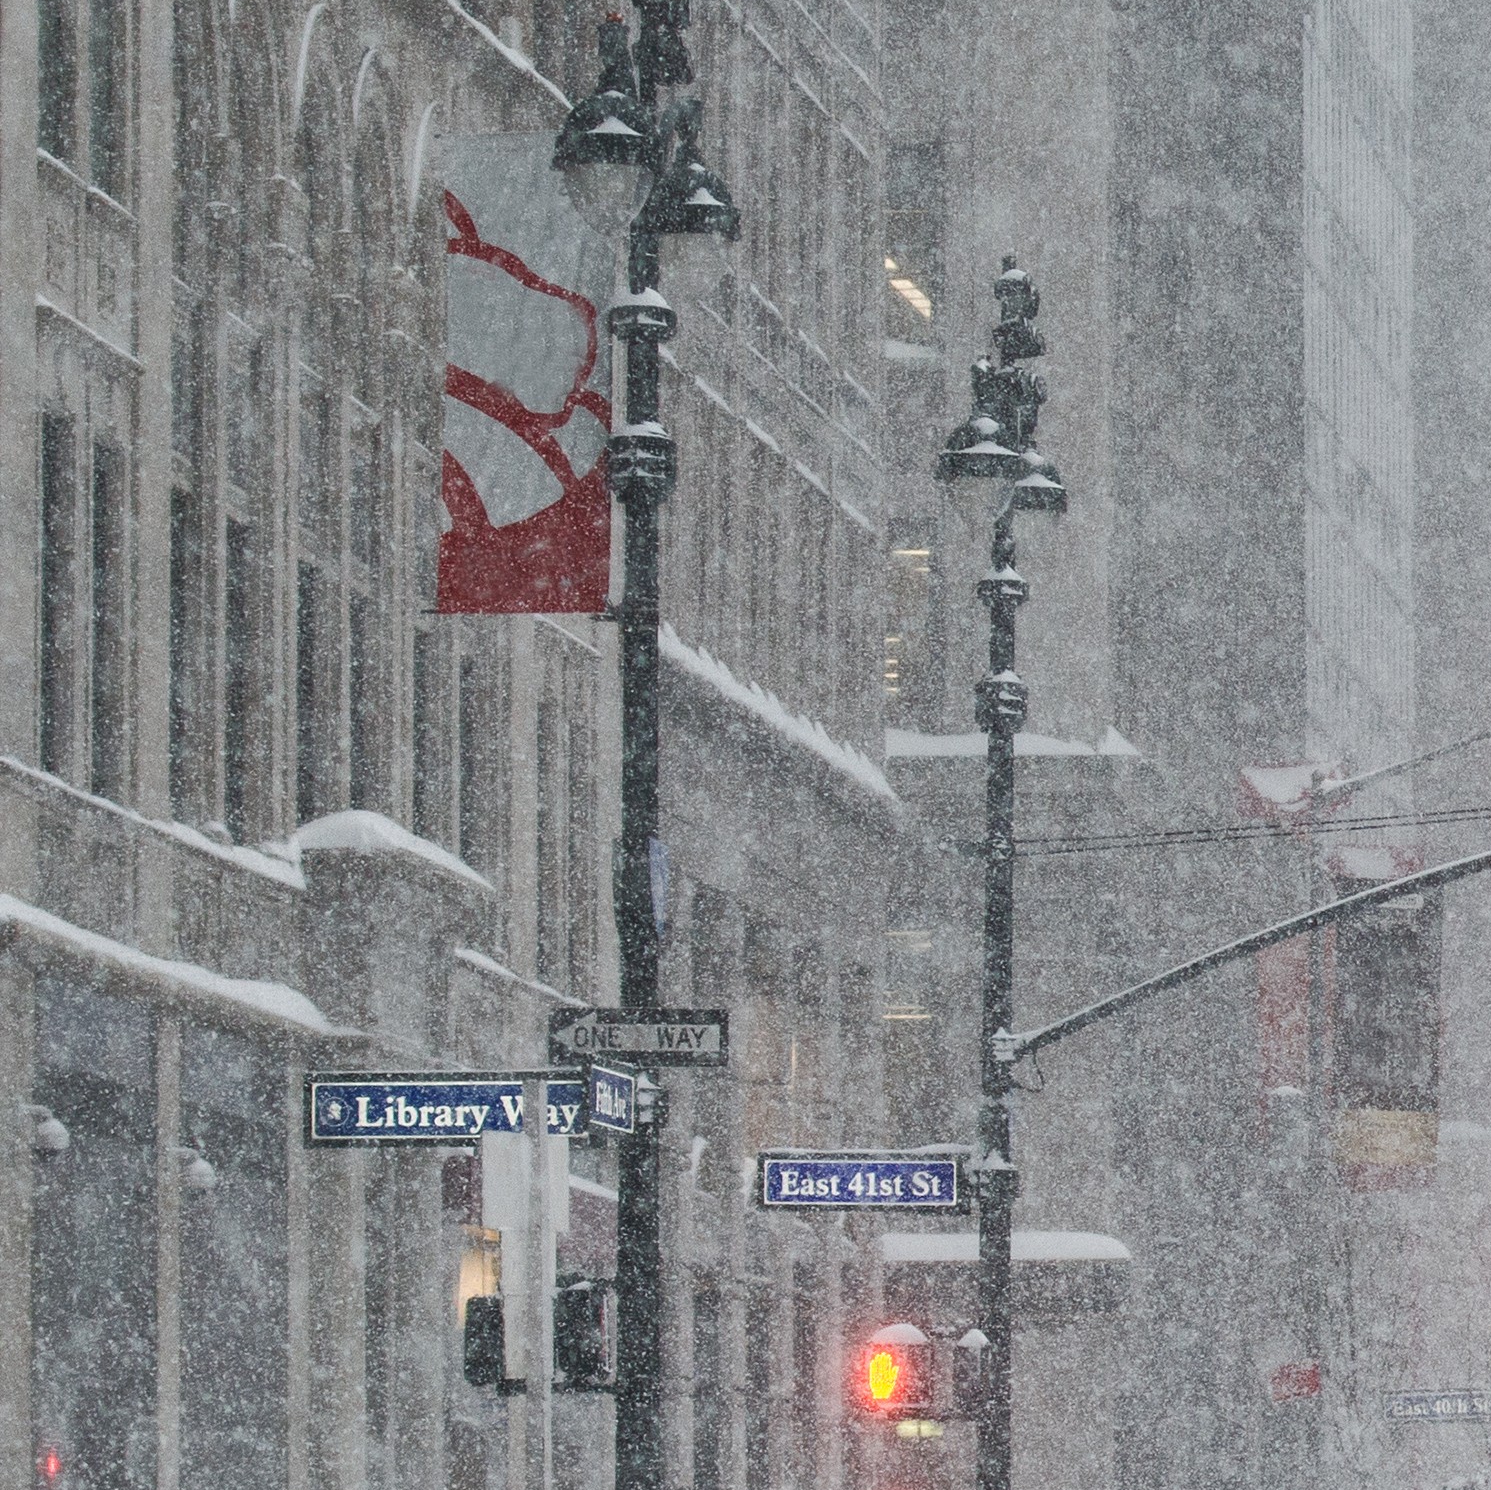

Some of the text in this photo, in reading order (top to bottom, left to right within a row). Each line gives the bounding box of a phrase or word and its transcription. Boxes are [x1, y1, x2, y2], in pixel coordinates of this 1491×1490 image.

[573, 1025, 707, 1049] ONE WAY
[355, 1095, 581, 1134] Library Way
[780, 1170, 942, 1197] East 41st St
